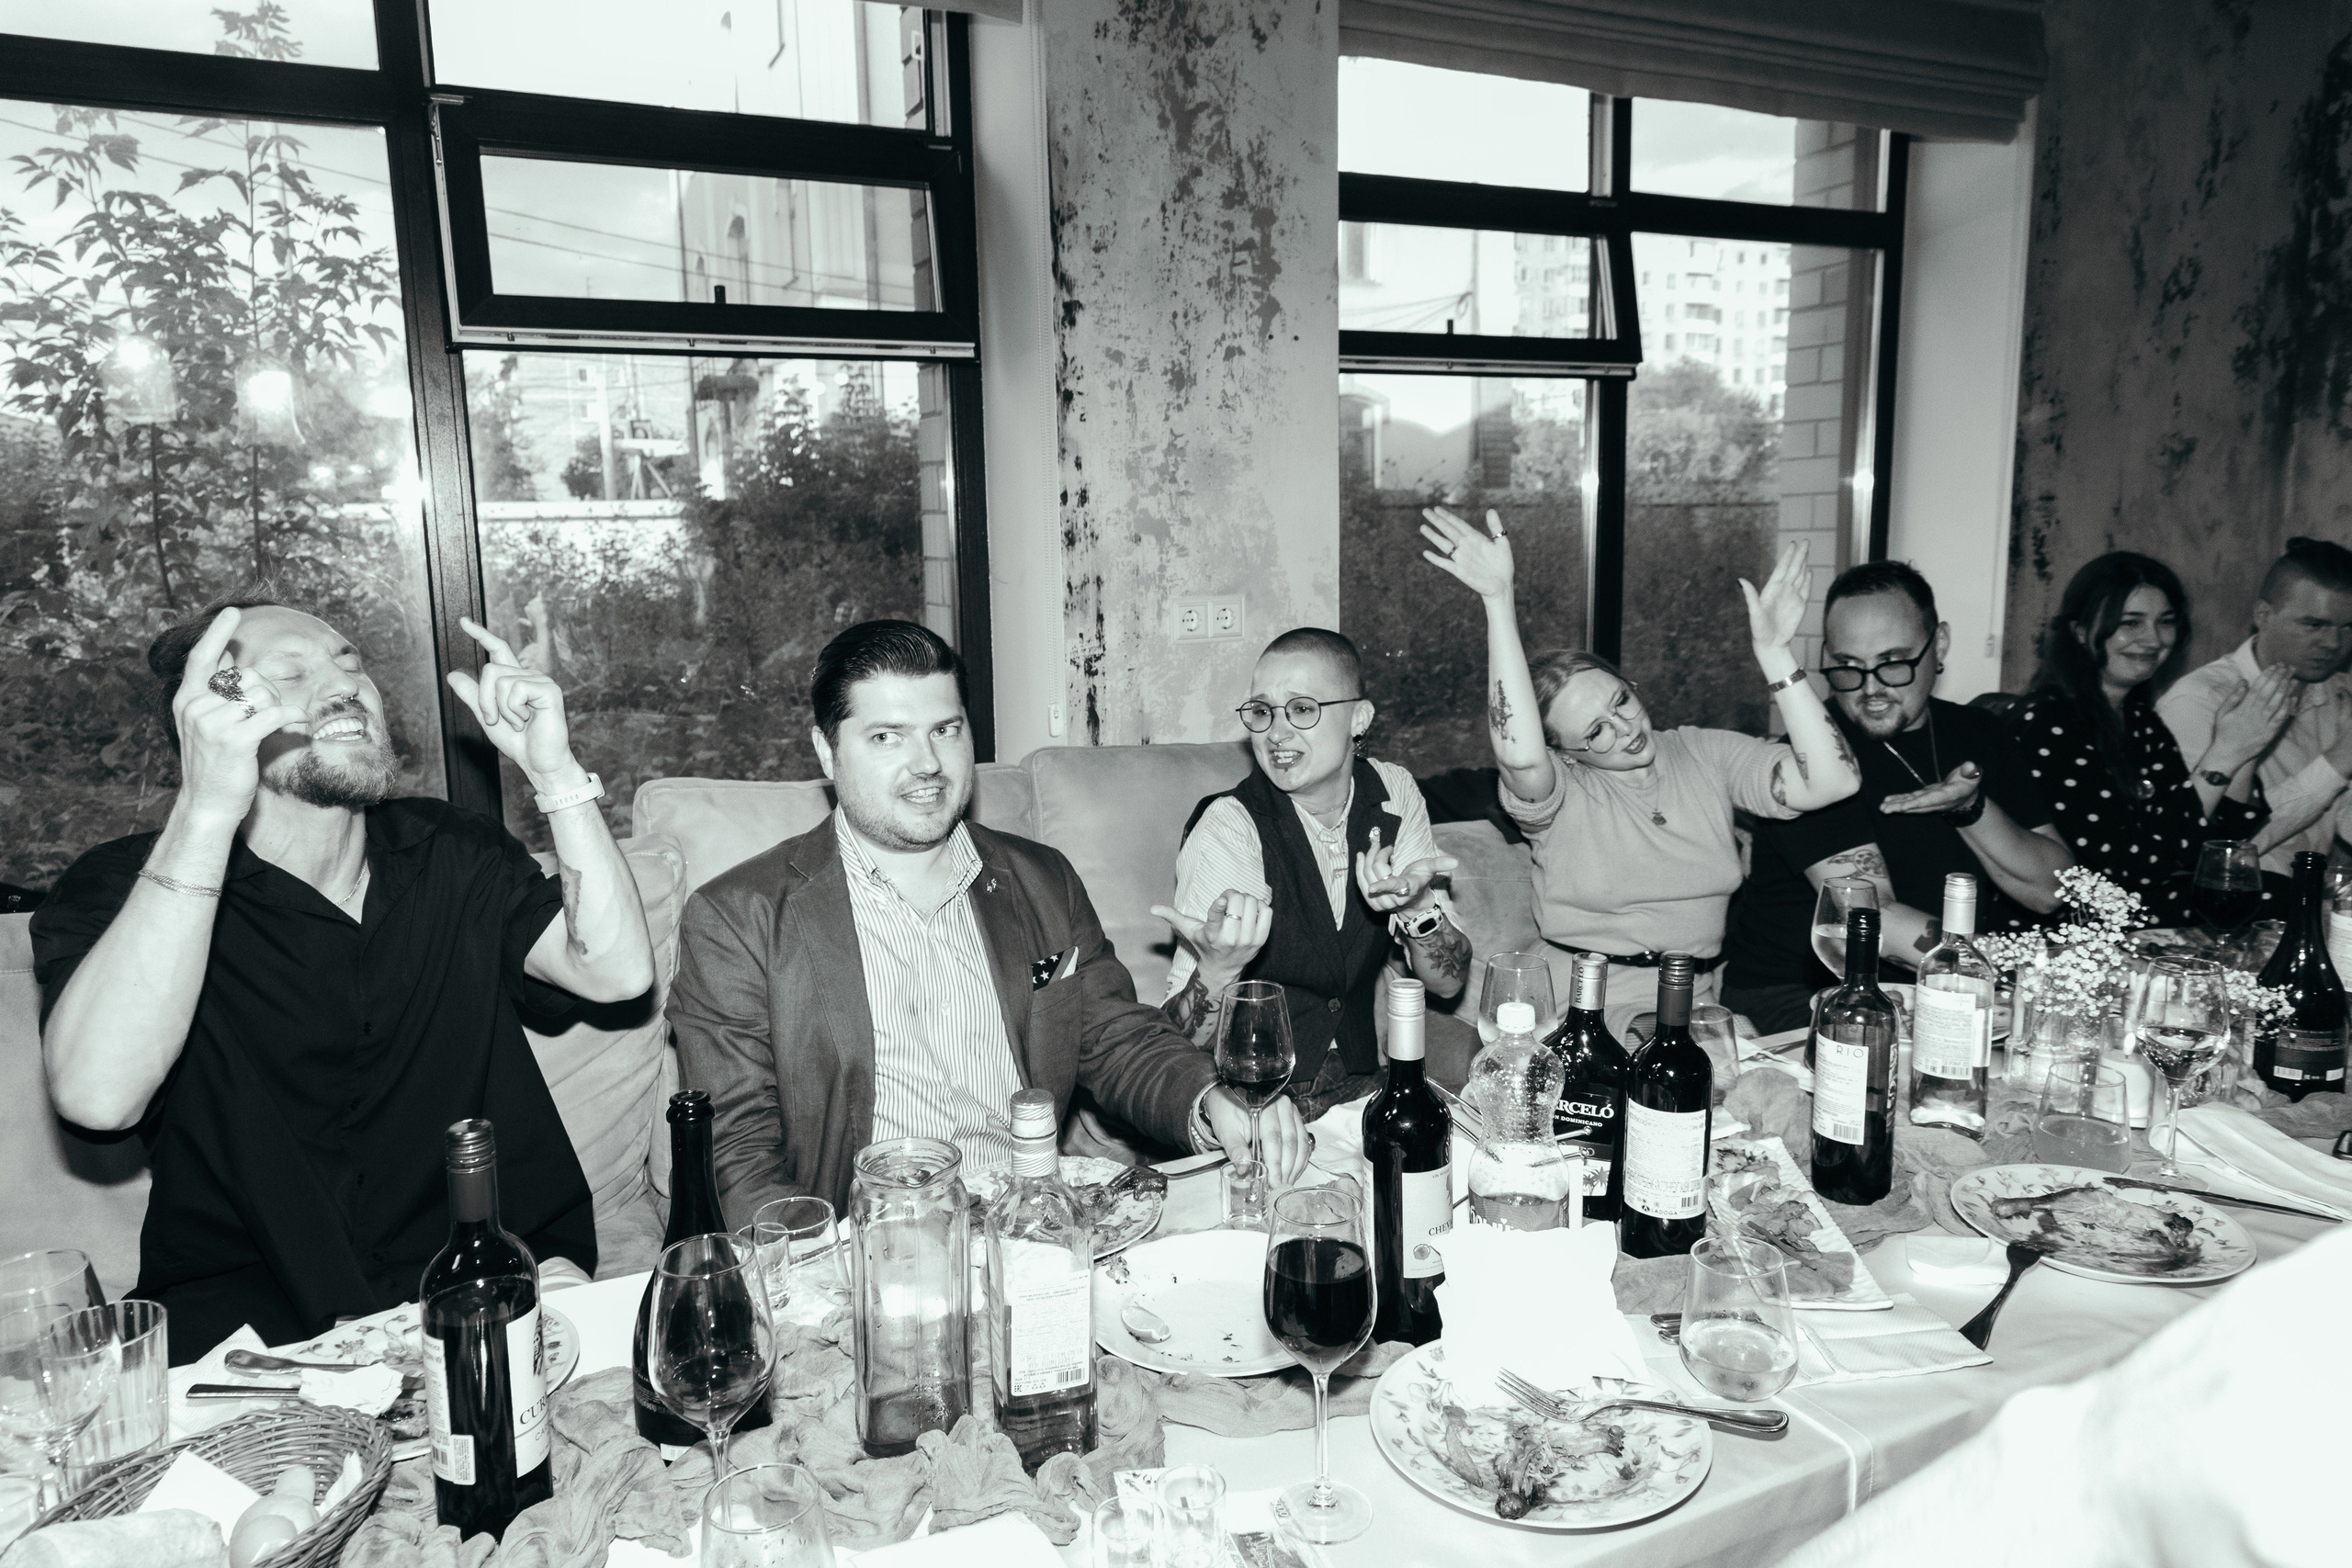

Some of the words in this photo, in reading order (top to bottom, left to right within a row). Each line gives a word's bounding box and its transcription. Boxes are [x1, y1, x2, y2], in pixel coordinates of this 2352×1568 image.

[1836, 1044, 1864, 1058] RIO
[1555, 1099, 1615, 1119] RCELÓ
[1560, 1115, 1603, 1128] DOMINICANO
[1651, 1207, 1678, 1216] LADOGA
[520, 1392, 548, 1425] CUR
